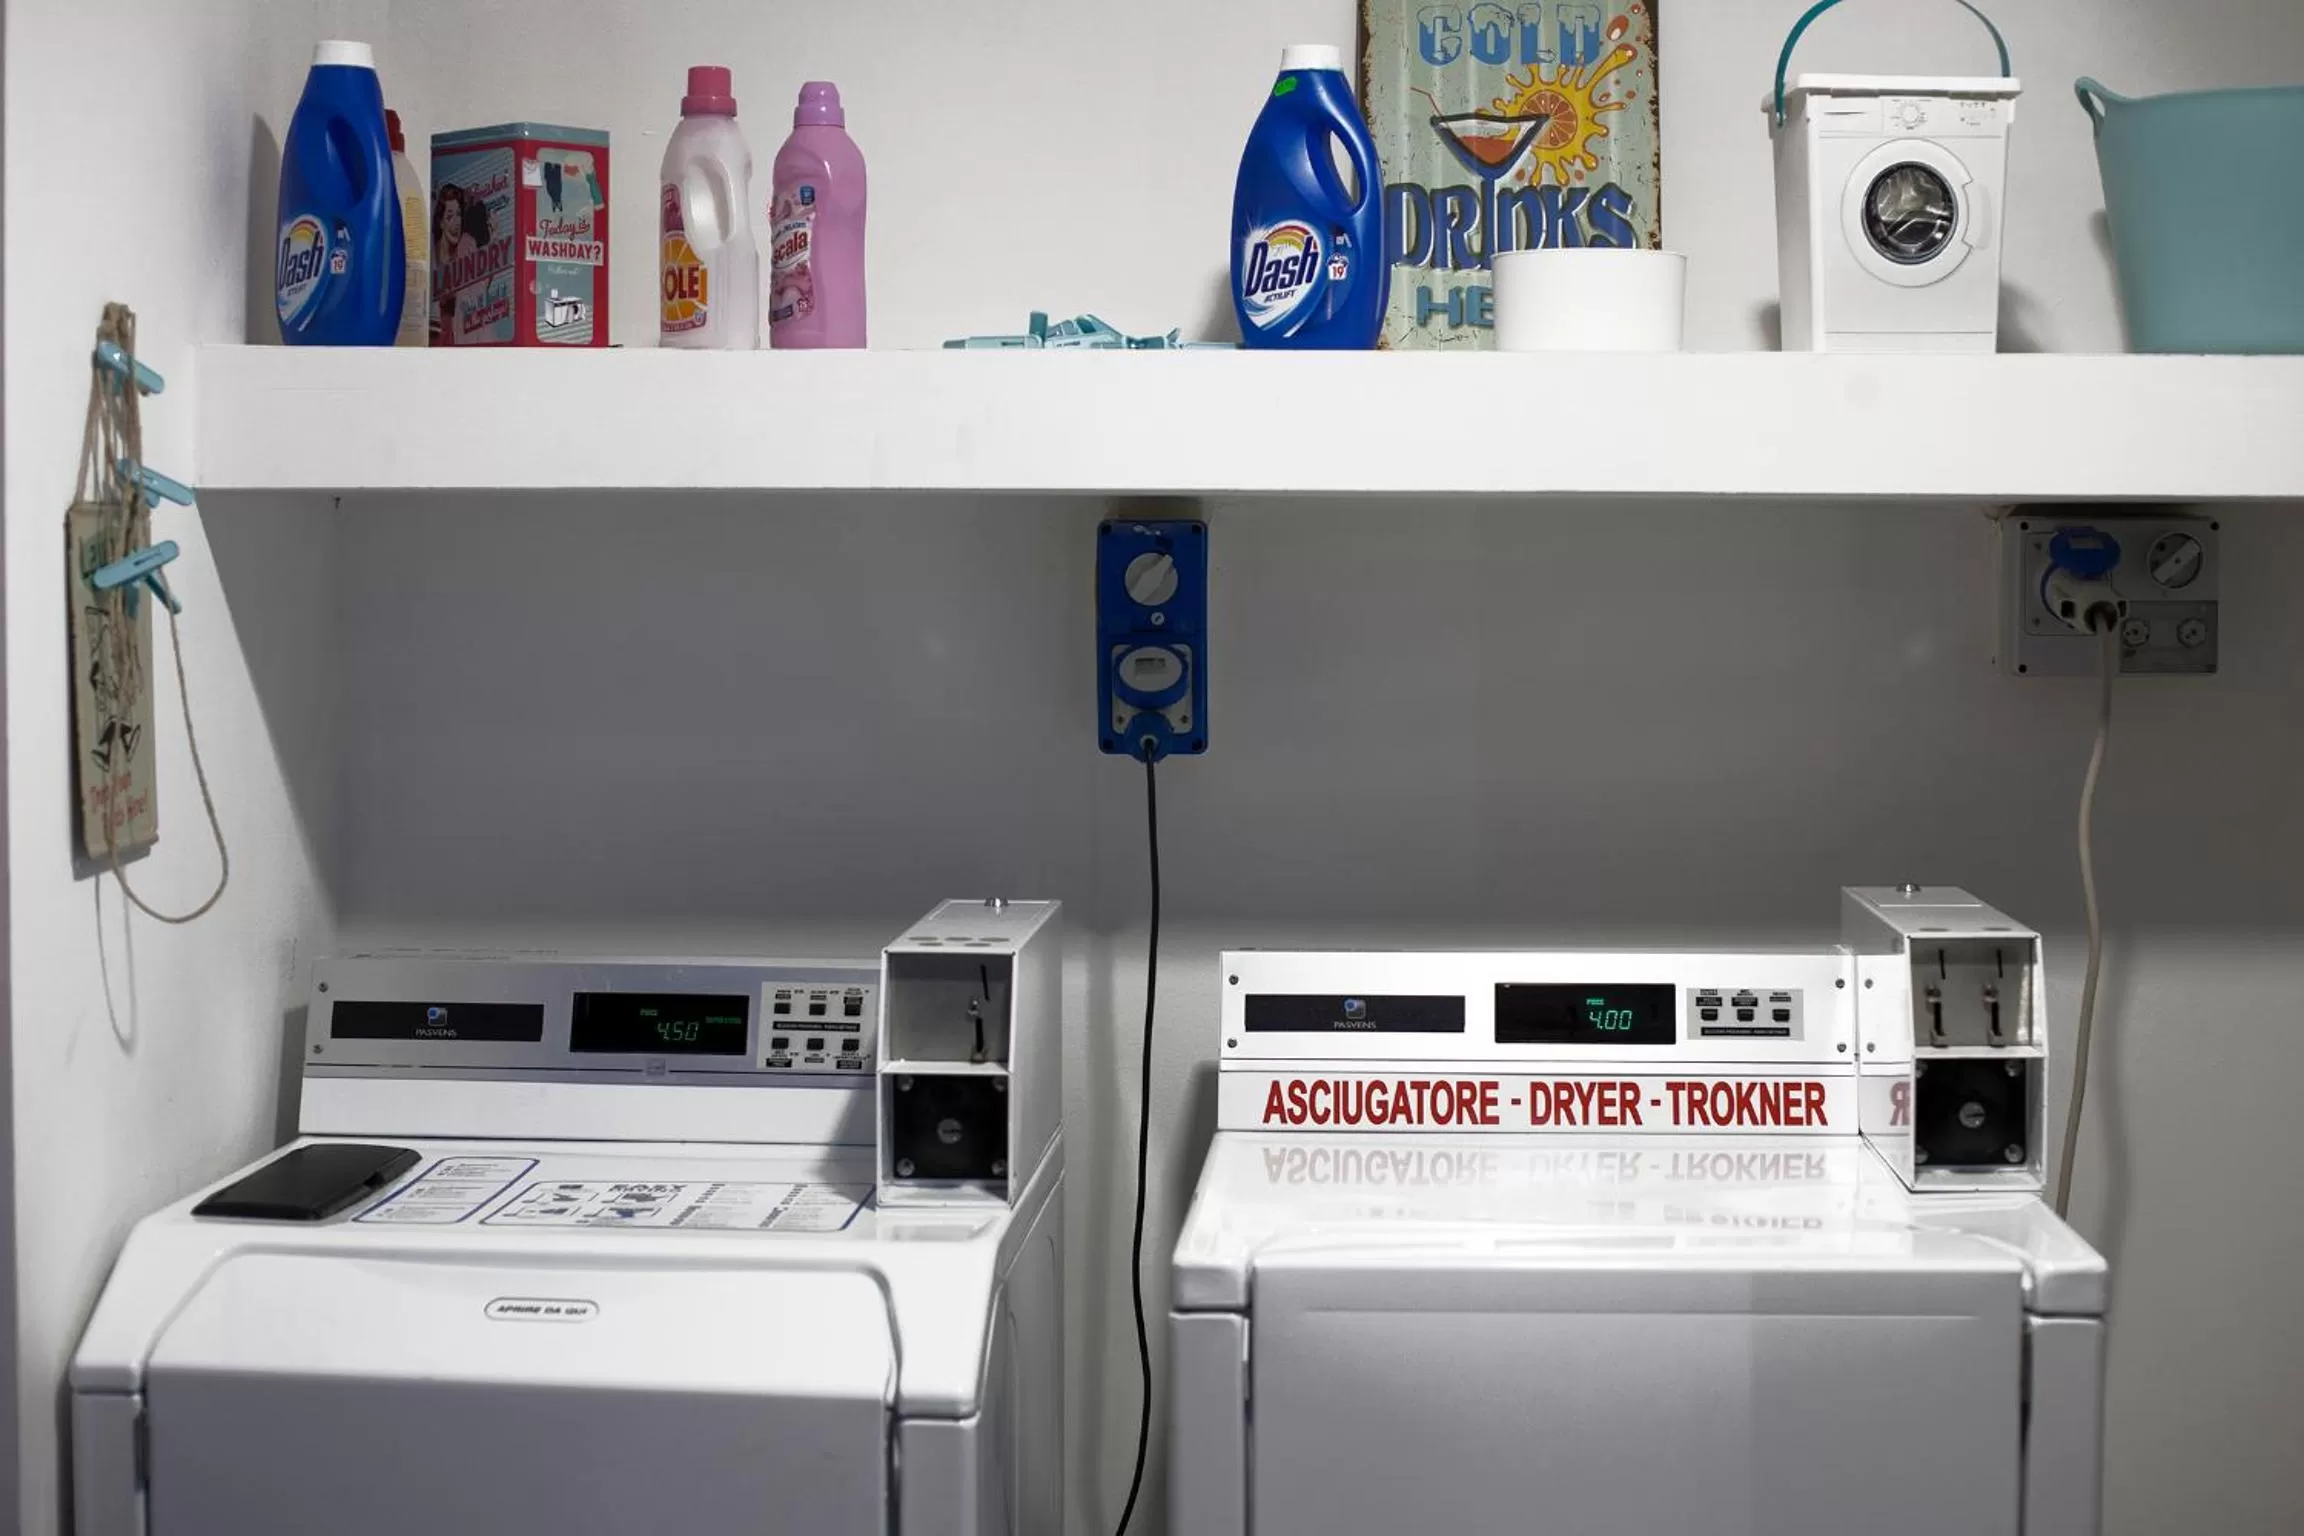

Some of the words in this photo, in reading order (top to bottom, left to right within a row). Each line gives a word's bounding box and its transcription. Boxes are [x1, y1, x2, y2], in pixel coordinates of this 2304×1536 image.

[1417, 3, 1601, 67] COLD
[539, 217, 576, 240] Today
[1383, 182, 1638, 268] DRINKS
[278, 230, 325, 291] Dash
[433, 236, 513, 297] LAUNDRY
[528, 240, 602, 261] WASHDAY?
[1244, 235, 1320, 298] Dash
[1332, 265, 1345, 278] 19
[1416, 285, 1494, 328] HE
[657, 1021, 700, 1041] 4.50
[1333, 1021, 1377, 1030] PASVENS
[1589, 1010, 1633, 1030] 4.00
[1264, 1080, 1500, 1126] ASCIUGATORE
[1530, 1080, 1641, 1126] DRYER
[1667, 1080, 1827, 1127] TROKNER
